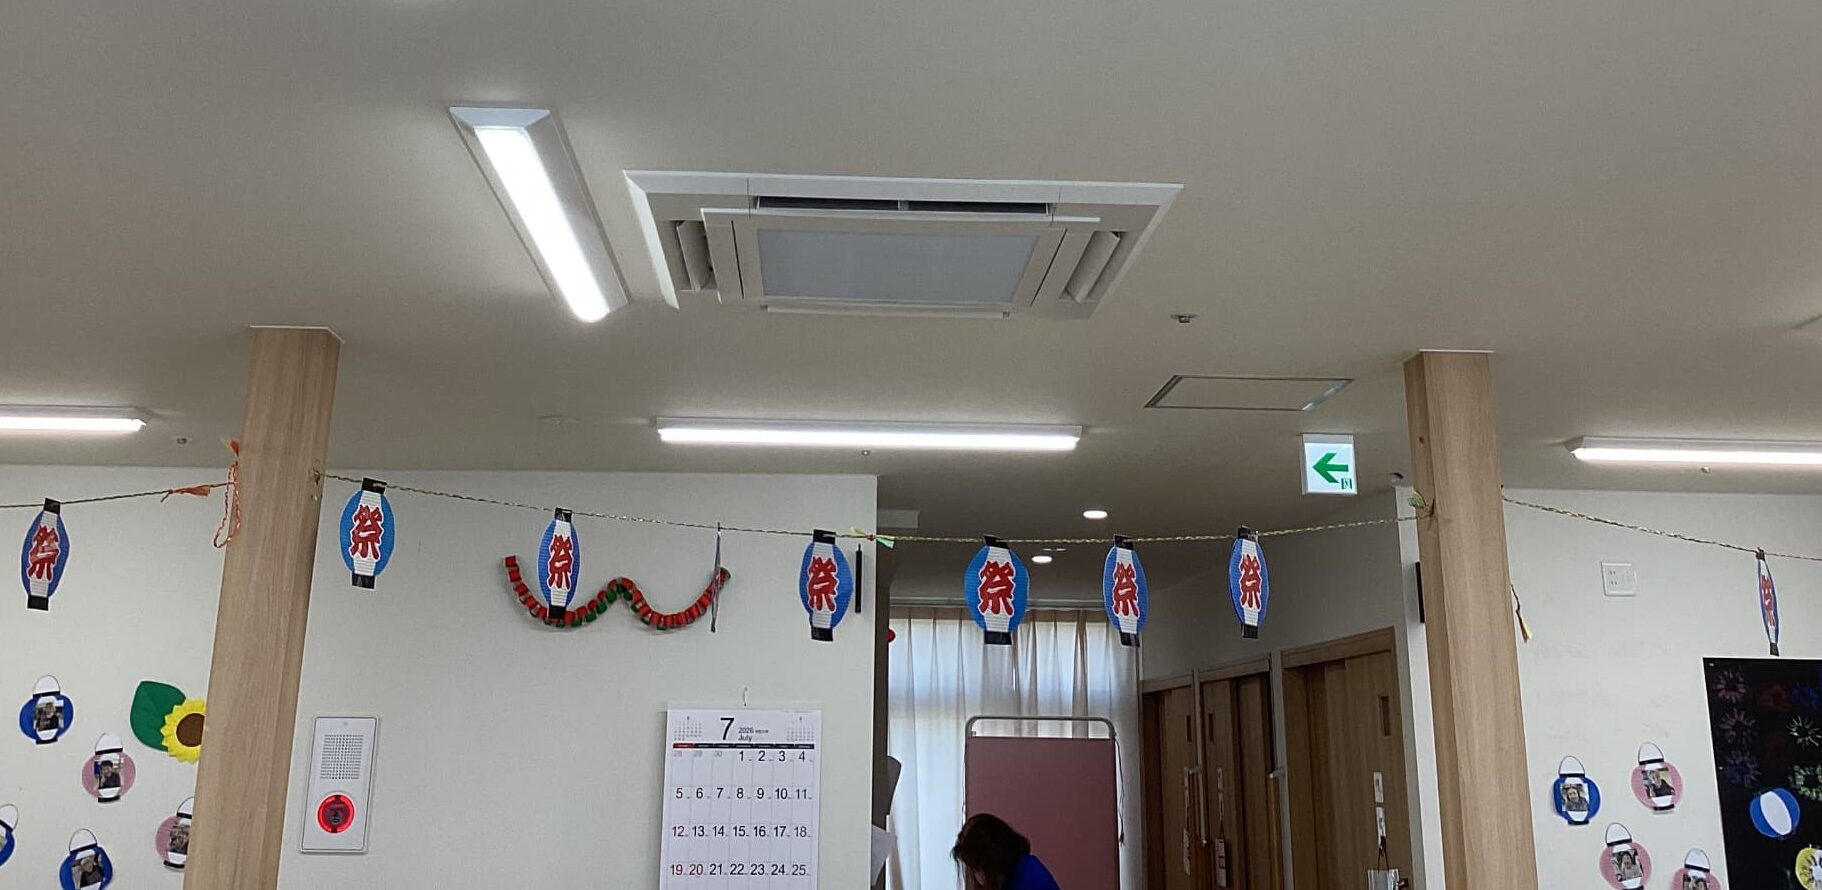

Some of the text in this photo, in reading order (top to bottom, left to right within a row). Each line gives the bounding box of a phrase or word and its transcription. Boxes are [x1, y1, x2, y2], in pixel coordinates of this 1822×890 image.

[27, 524, 60, 581] 祭
[350, 504, 384, 560] 祭
[548, 533, 573, 590] 祭
[808, 556, 838, 612] 祭
[979, 560, 1015, 616] 祭
[1113, 561, 1139, 618] 祭
[1240, 553, 1261, 610] 祭
[720, 717, 735, 740] 7
[738, 734, 753, 742] July
[738, 750, 744, 762] 1
[757, 750, 767, 761] 2
[778, 751, 786, 762] 3
[798, 751, 806, 762] 4
[675, 787, 806, 800] 5 6 7 8 9 10 11
[672, 825, 807, 837] 12 13 14 15 16 17 18
[670, 863, 806, 875] 19 20 21 22 23 24 25
